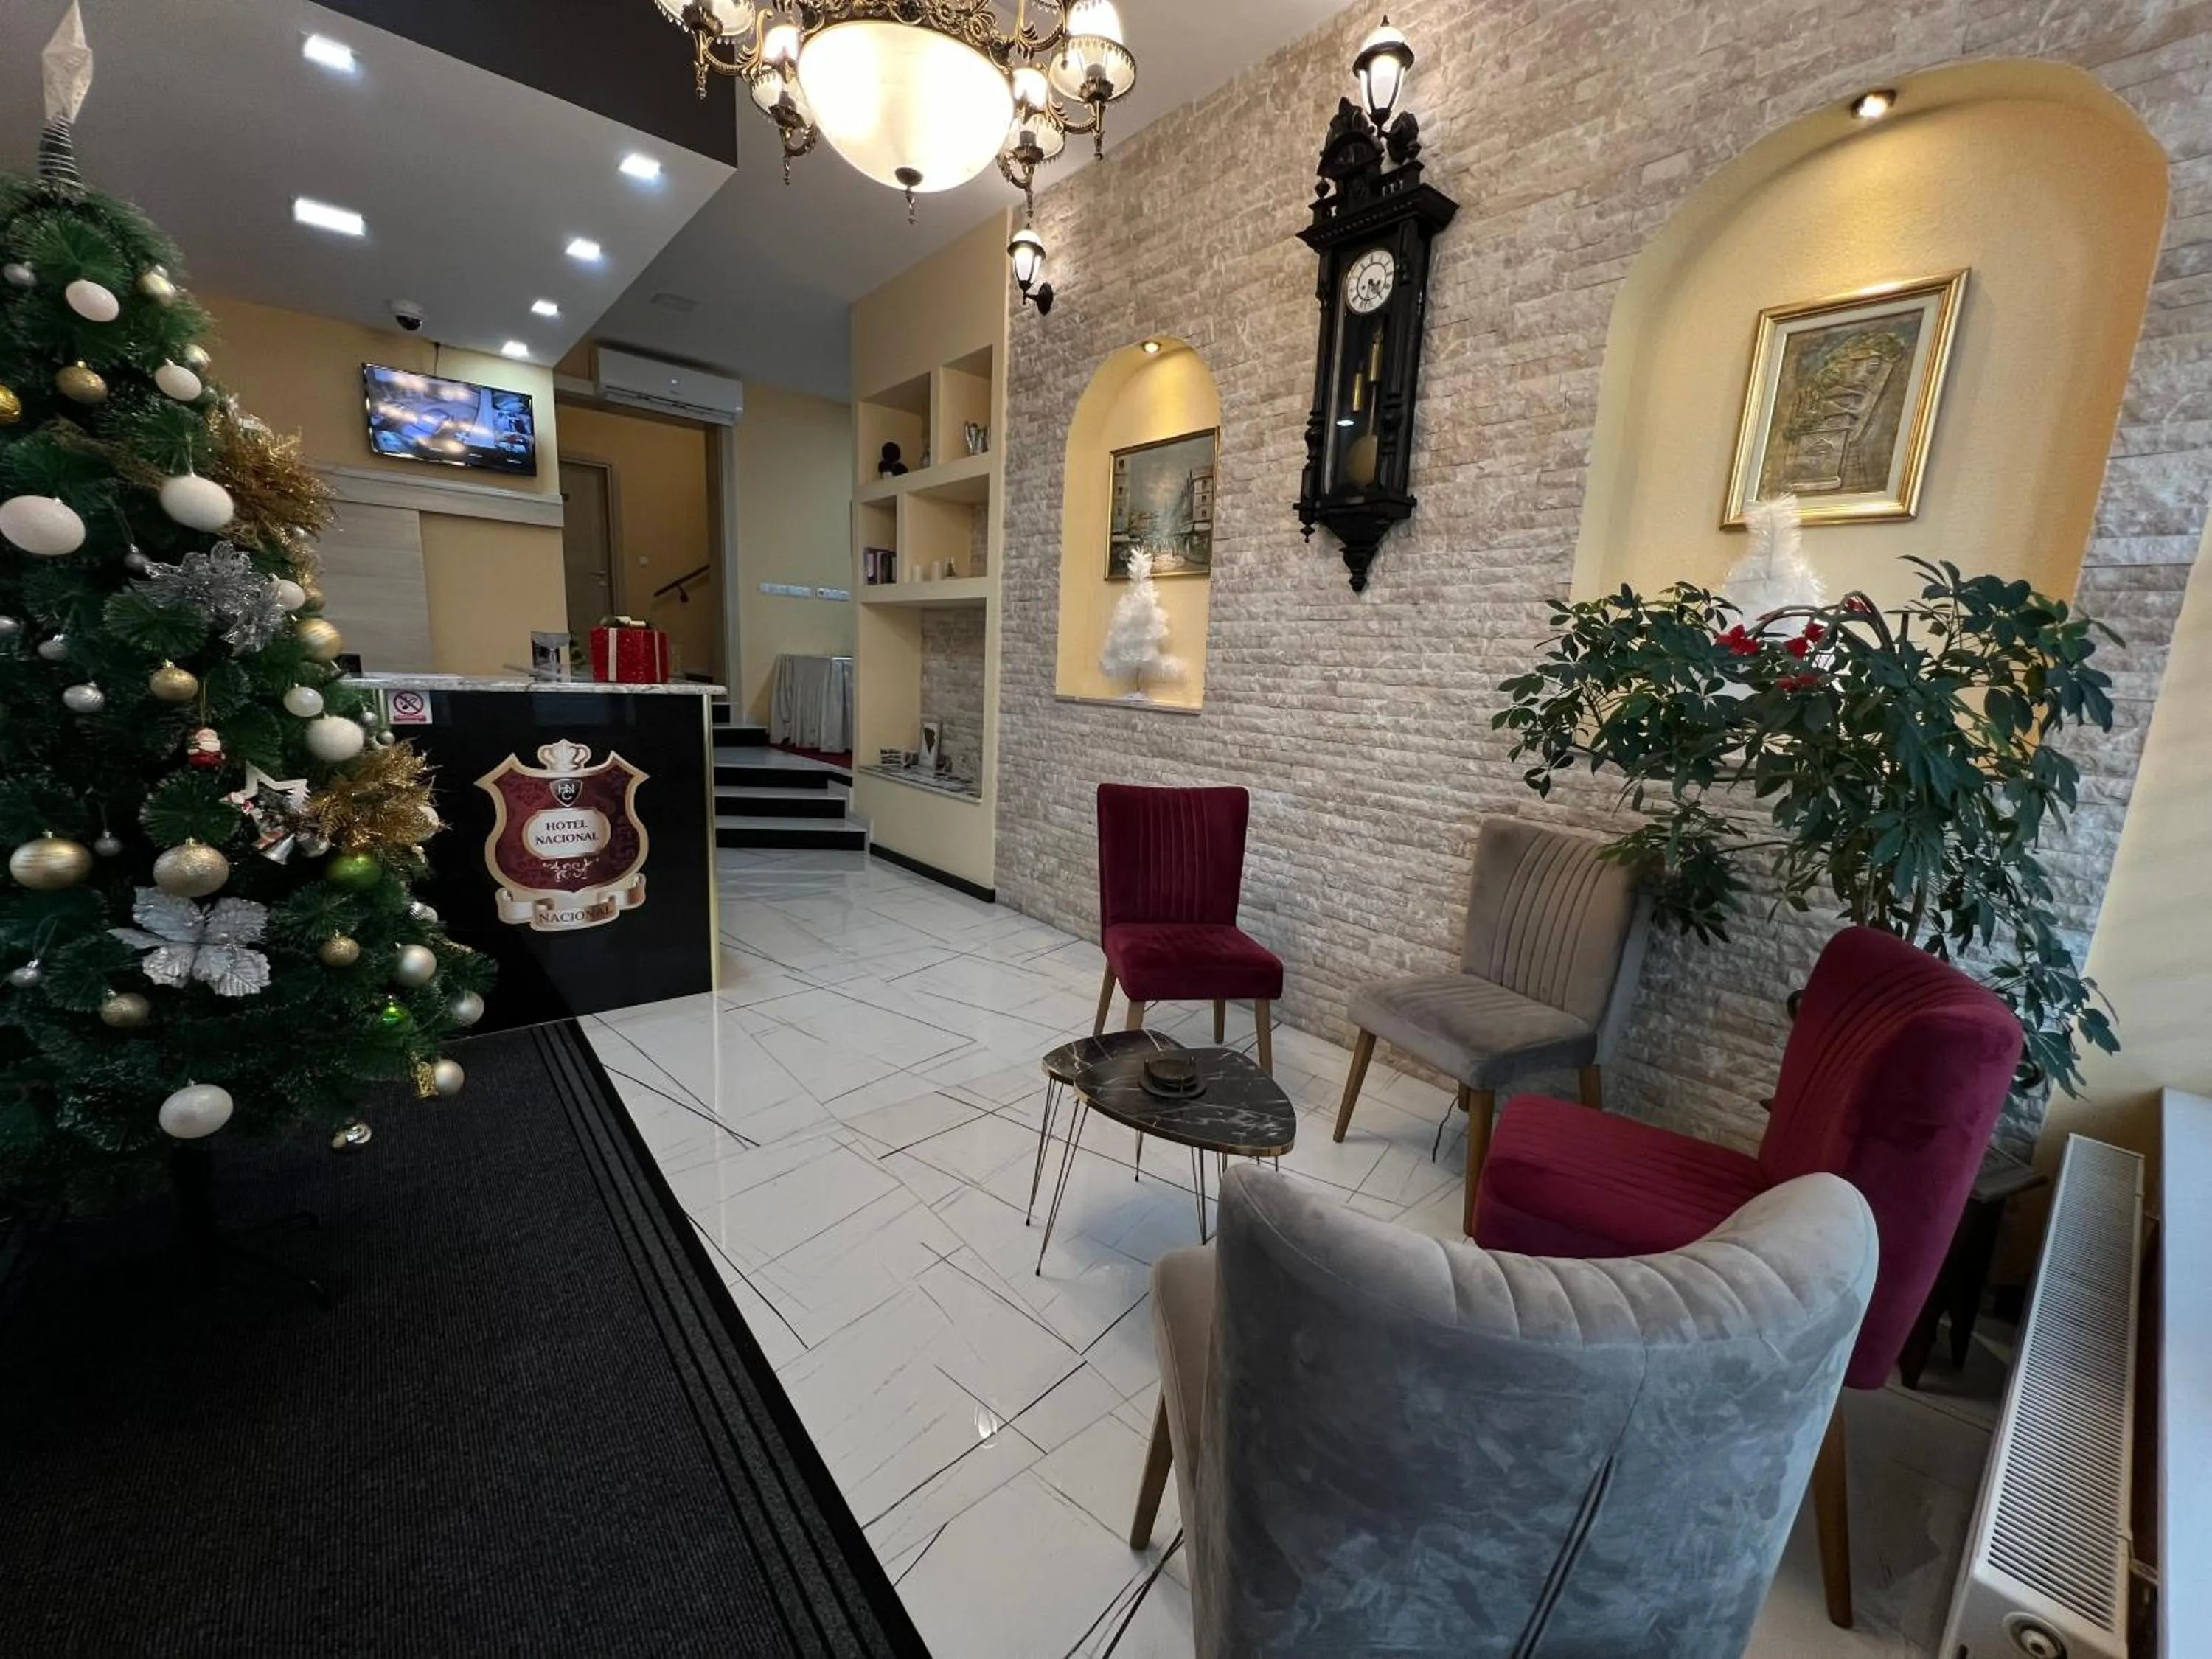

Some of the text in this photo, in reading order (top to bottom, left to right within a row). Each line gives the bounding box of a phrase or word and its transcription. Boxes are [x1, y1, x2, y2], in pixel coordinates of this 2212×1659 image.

[546, 819, 588, 831] HOTEL
[535, 832, 599, 846] NACIONAL
[539, 904, 614, 923] NACIONAL
